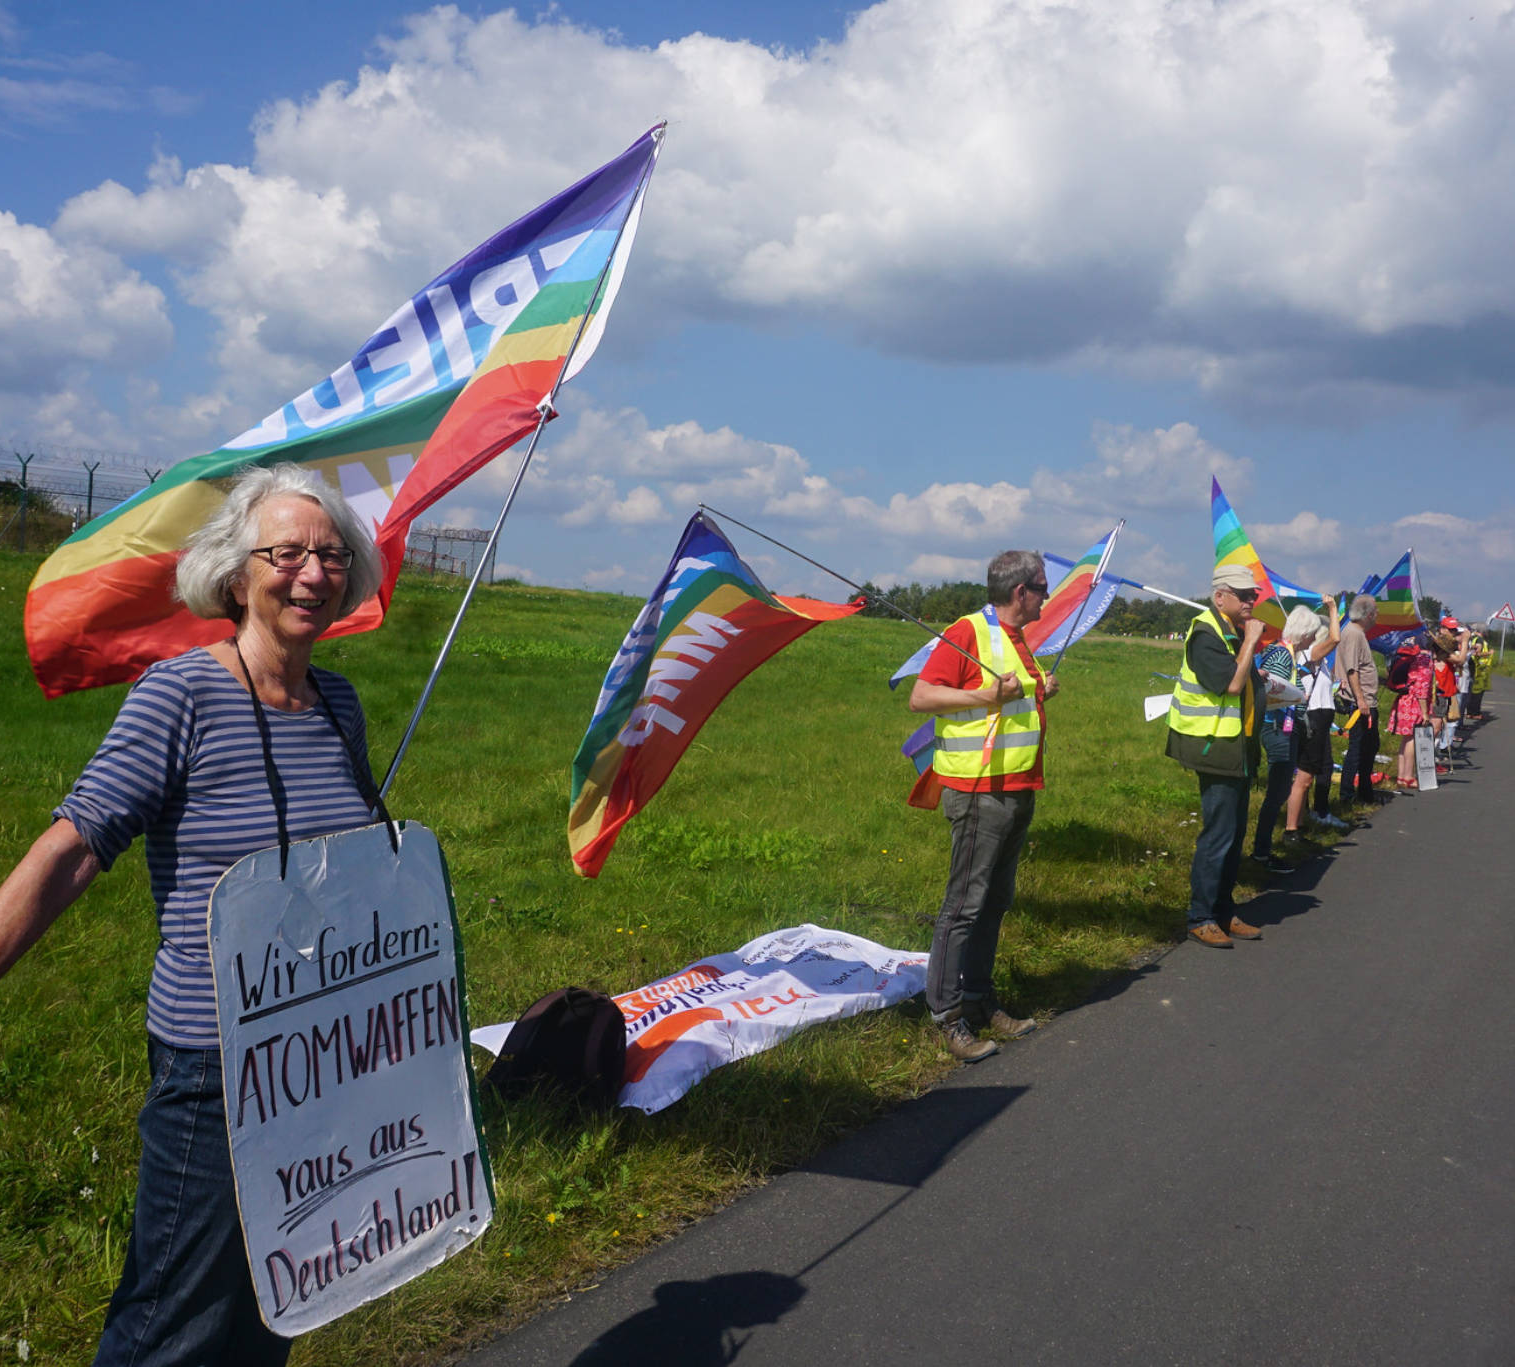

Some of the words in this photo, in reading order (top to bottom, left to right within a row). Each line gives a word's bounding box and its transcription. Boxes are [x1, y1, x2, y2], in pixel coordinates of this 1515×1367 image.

[237, 942, 300, 1011] Wir
[318, 910, 440, 988] fordern:
[237, 976, 460, 1129] ATOMWAFFEN
[275, 1144, 353, 1206] raus
[369, 1113, 425, 1160] aus
[265, 1150, 480, 1318] Deutschland!
